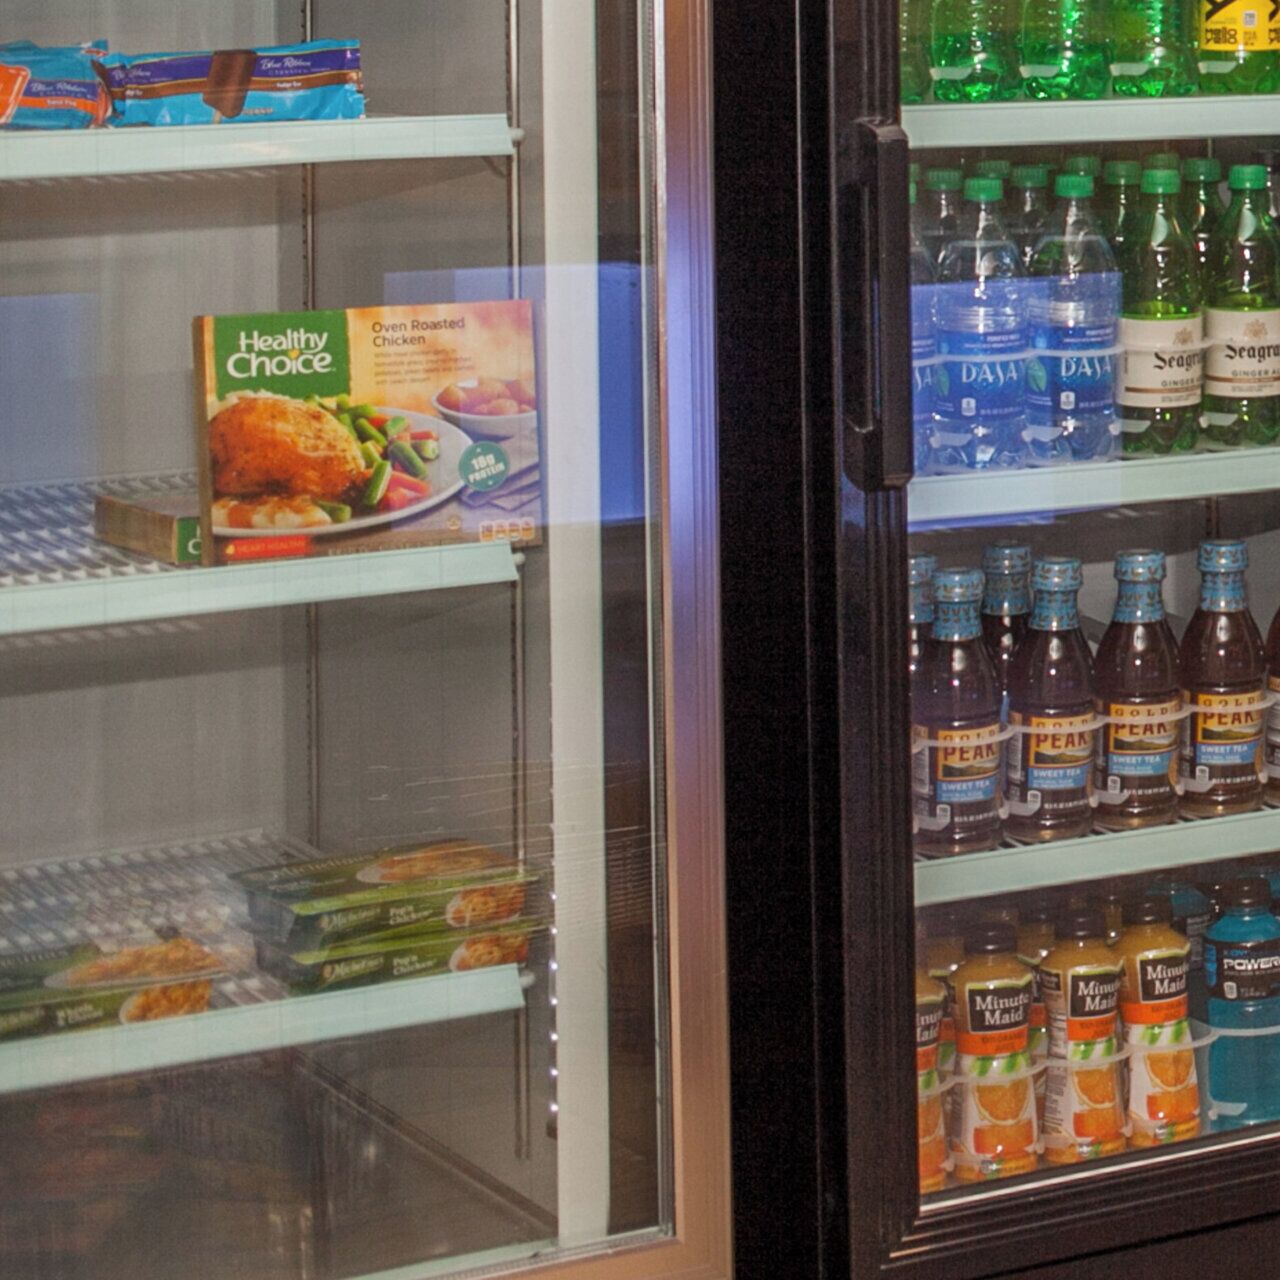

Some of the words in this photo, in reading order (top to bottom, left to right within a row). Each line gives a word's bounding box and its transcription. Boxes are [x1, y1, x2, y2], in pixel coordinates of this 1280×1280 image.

[371, 320, 407, 334] Oven
[411, 317, 466, 331] Roasted
[239, 327, 328, 354] Healthy
[373, 334, 426, 348] Chicken
[227, 349, 333, 378] Choice
[1114, 706, 1169, 718] GOLD
[1114, 718, 1168, 737] PEAK
[1035, 730, 1089, 750] PEAK
[943, 742, 997, 762] PEAK
[974, 993, 1030, 1010] Minute
[984, 1009, 1024, 1026] Maid
